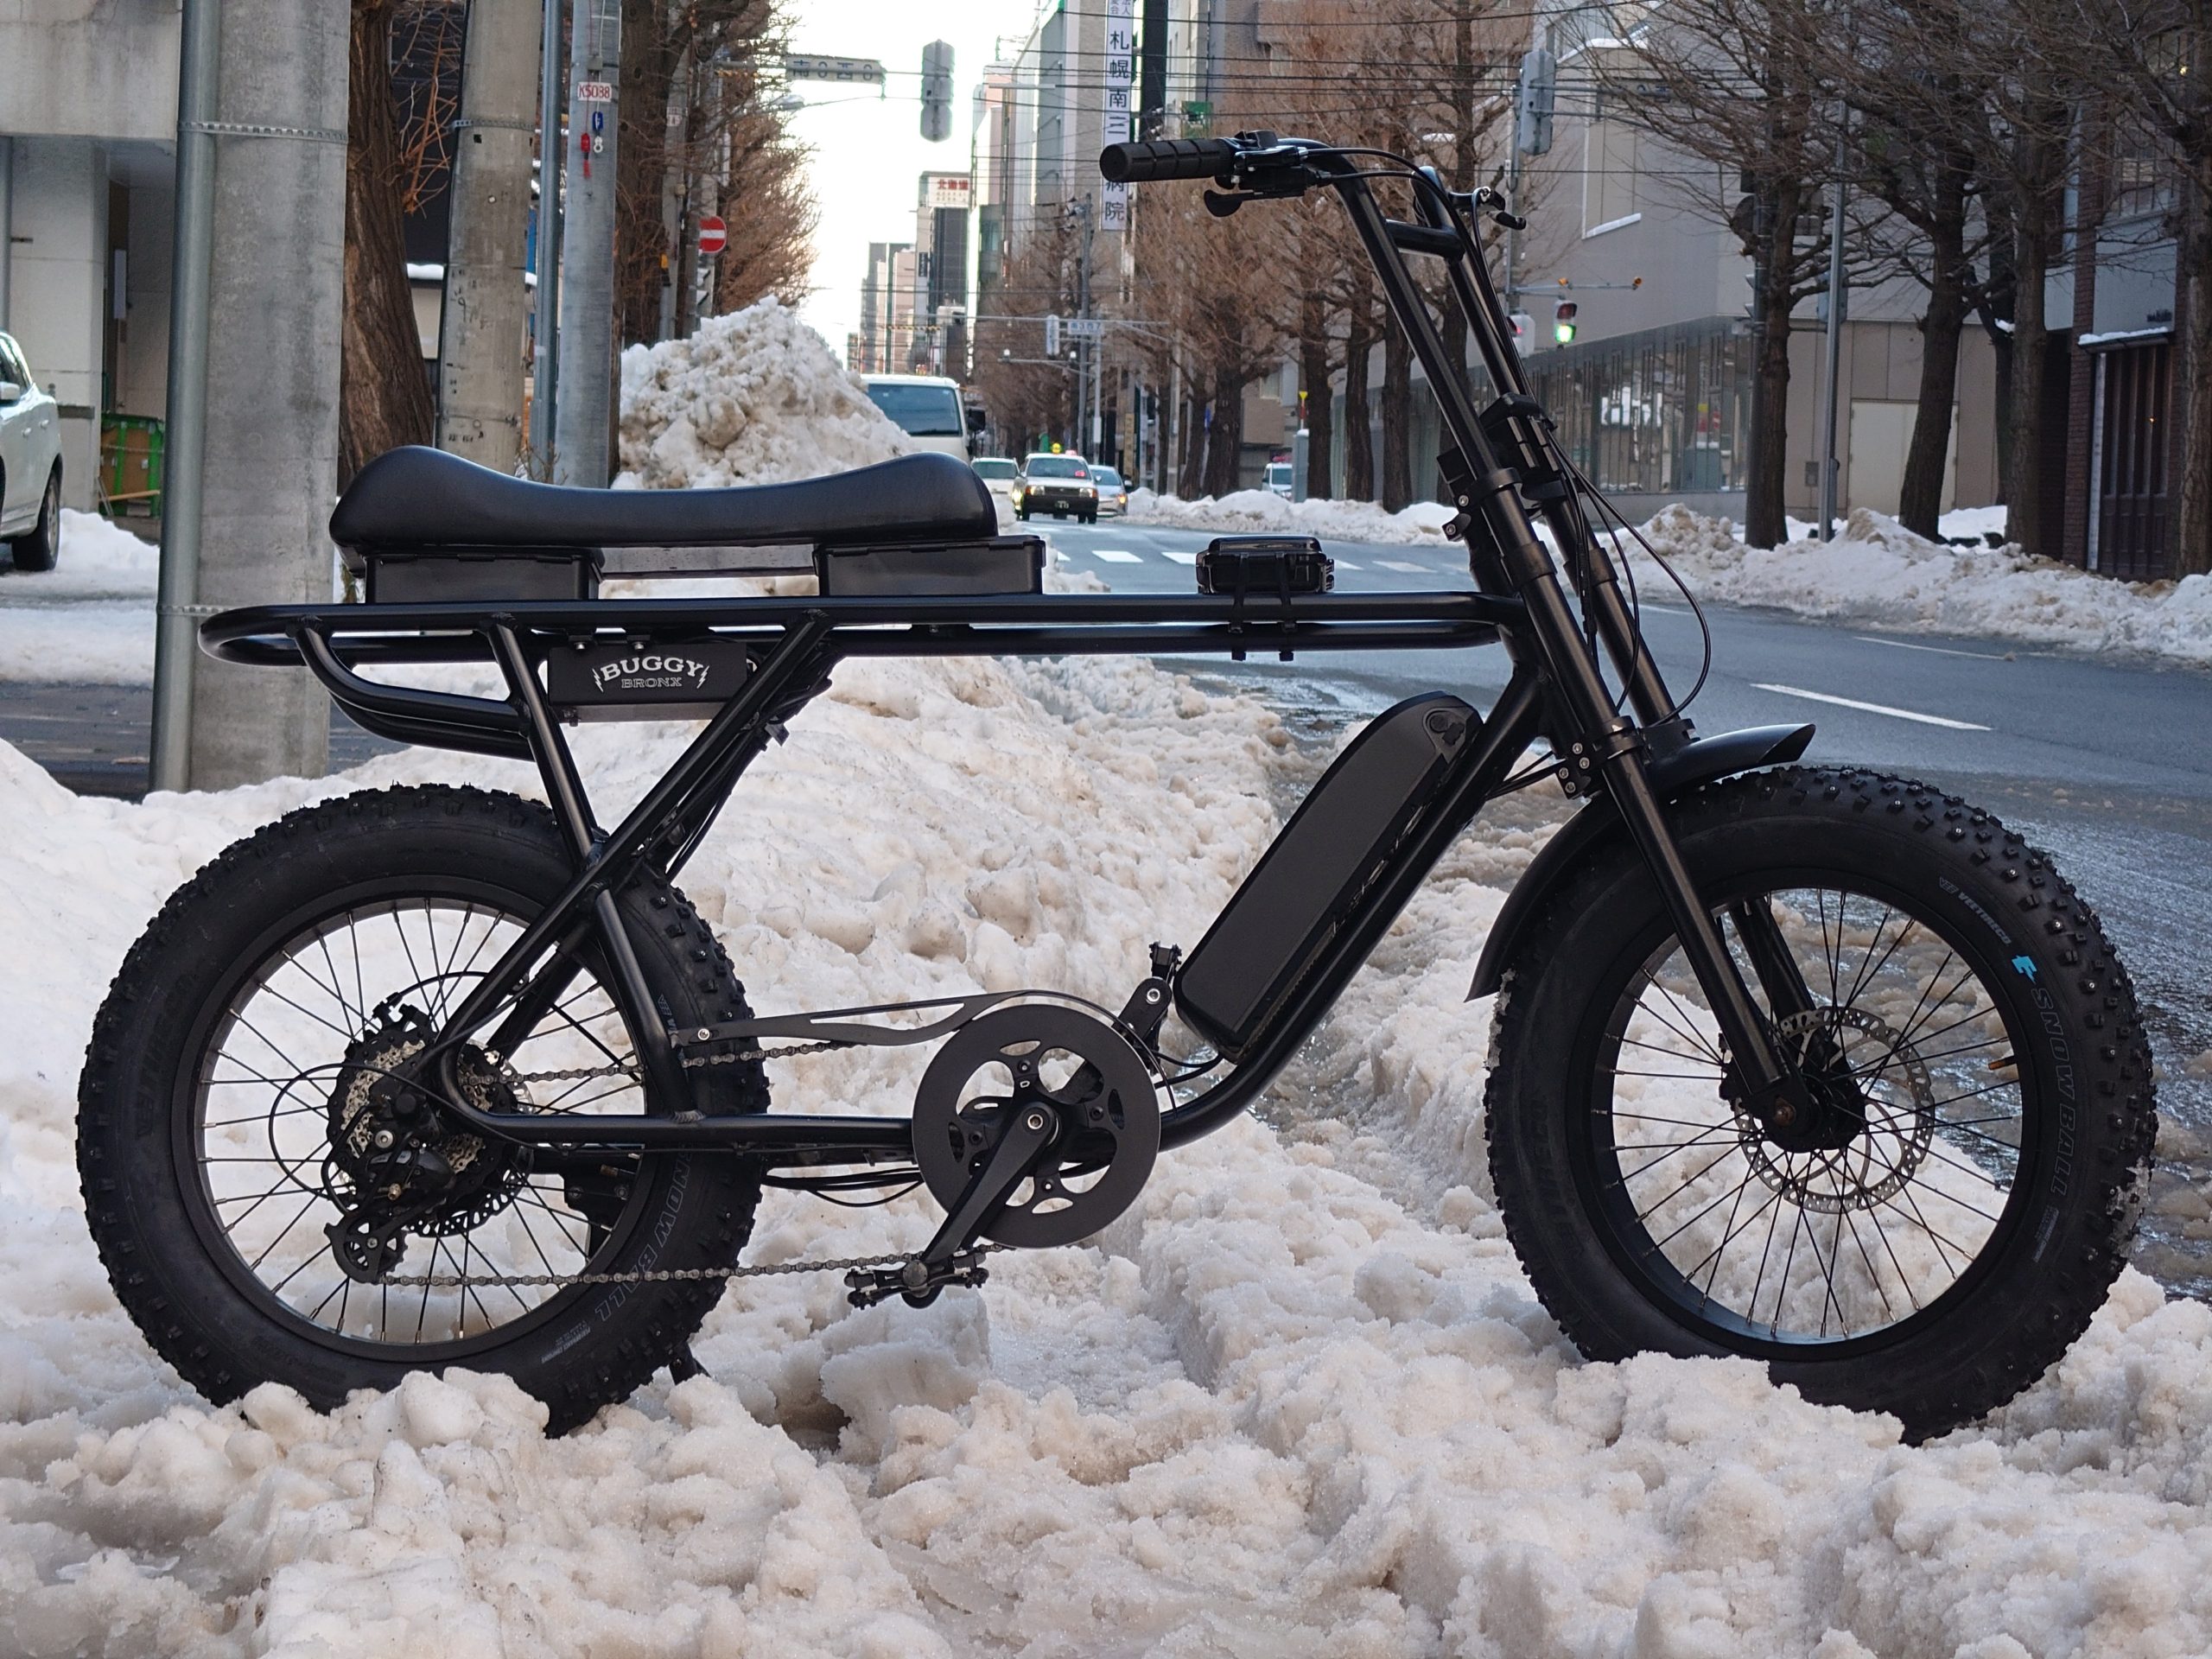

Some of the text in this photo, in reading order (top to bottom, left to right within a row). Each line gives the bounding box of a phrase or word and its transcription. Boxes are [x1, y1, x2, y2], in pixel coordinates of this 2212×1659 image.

[1105, 30, 1130, 220] 札幌南三院
[601, 656, 704, 682] BUGGY
[621, 677, 683, 689] BRONX
